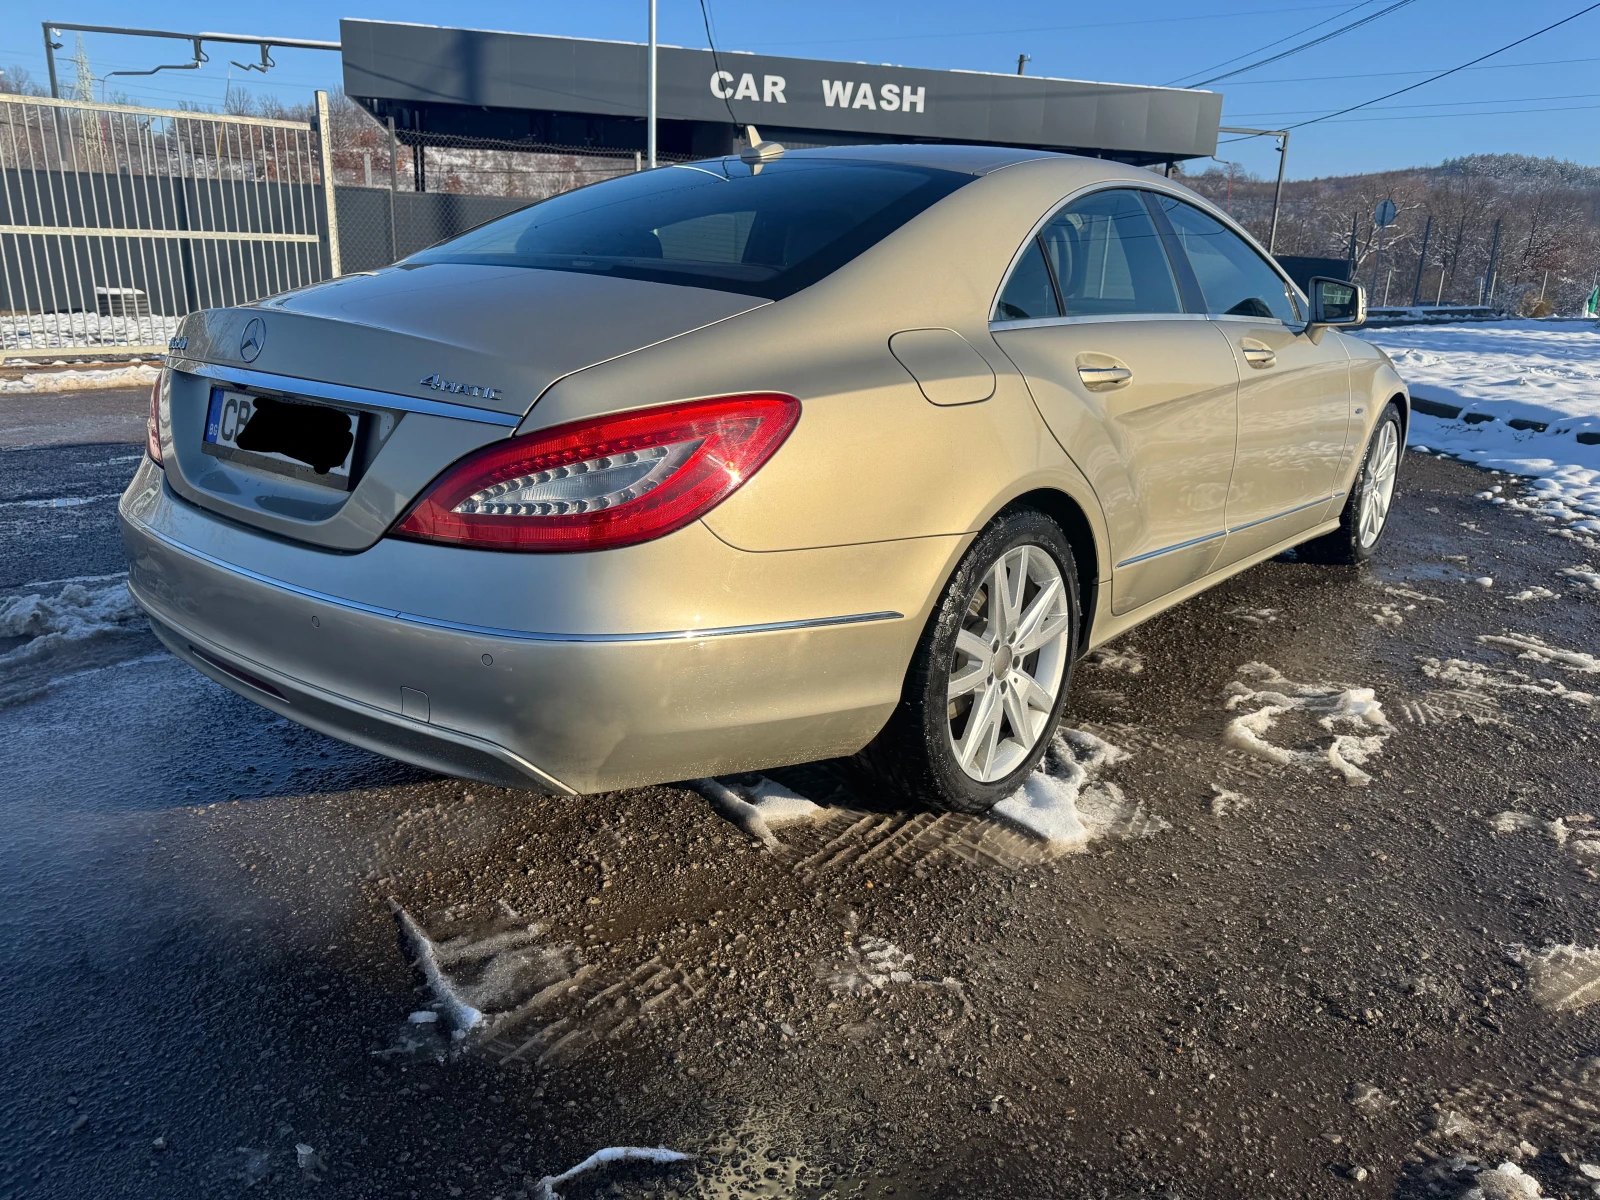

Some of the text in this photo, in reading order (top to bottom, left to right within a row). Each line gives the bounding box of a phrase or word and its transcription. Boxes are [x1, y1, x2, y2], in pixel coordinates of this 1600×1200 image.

[709, 70, 926, 113] CAR WASH
[420, 373, 502, 400] 4MATIC
[208, 423, 218, 436] BG
